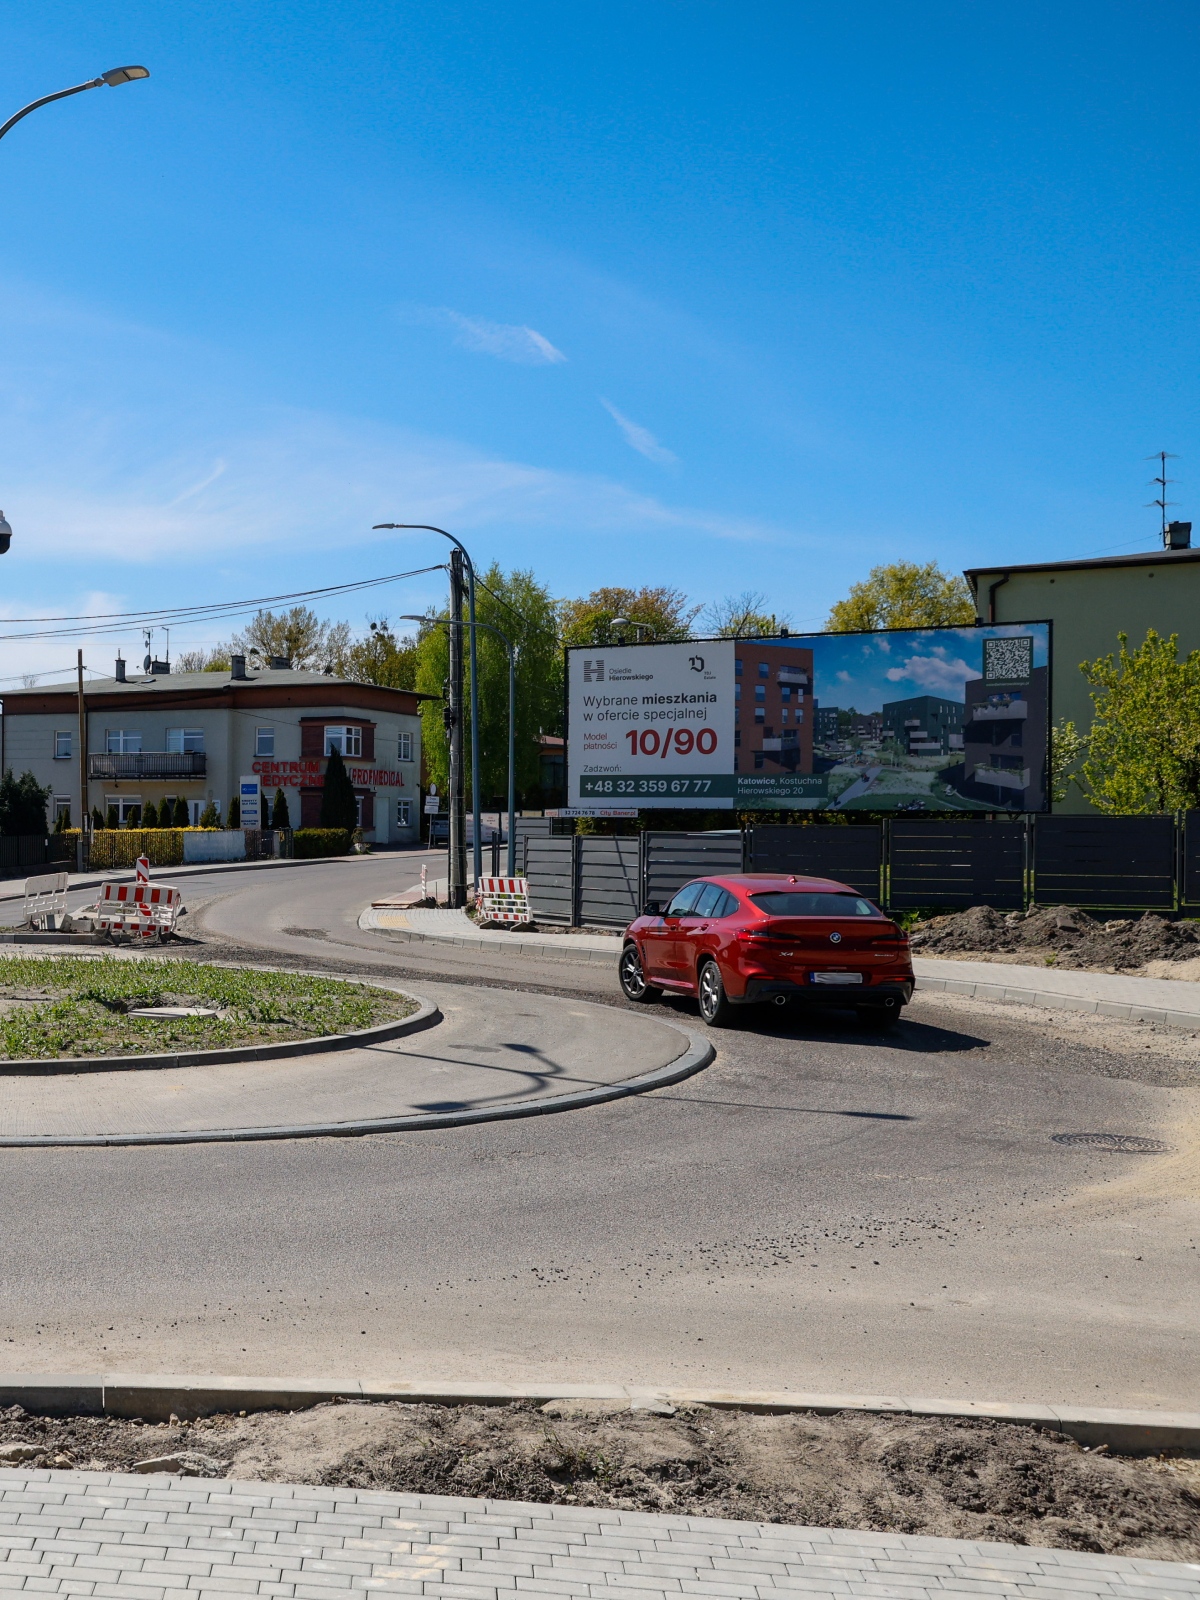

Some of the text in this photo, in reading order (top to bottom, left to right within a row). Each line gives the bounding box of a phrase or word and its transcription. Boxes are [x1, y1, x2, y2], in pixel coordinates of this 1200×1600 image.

[609, 674, 653, 682] Hierowskiego
[583, 691, 717, 709] Wybrane mieszkania
[583, 707, 707, 722] w ofercie specjalnej
[583, 733, 608, 741] Model
[583, 742, 618, 751] płatności
[625, 728, 718, 759] 10/90
[252, 761, 320, 773] CENTRUM
[583, 764, 622, 773] Zadzwoń:
[261, 774, 326, 787] EDYCZNE
[351, 768, 405, 786] PROFMEDICAL
[737, 777, 823, 786] Katowice, Kostuchna
[585, 779, 712, 792] +48 32 359 67 77
[737, 786, 804, 796] Hierowskiego 20
